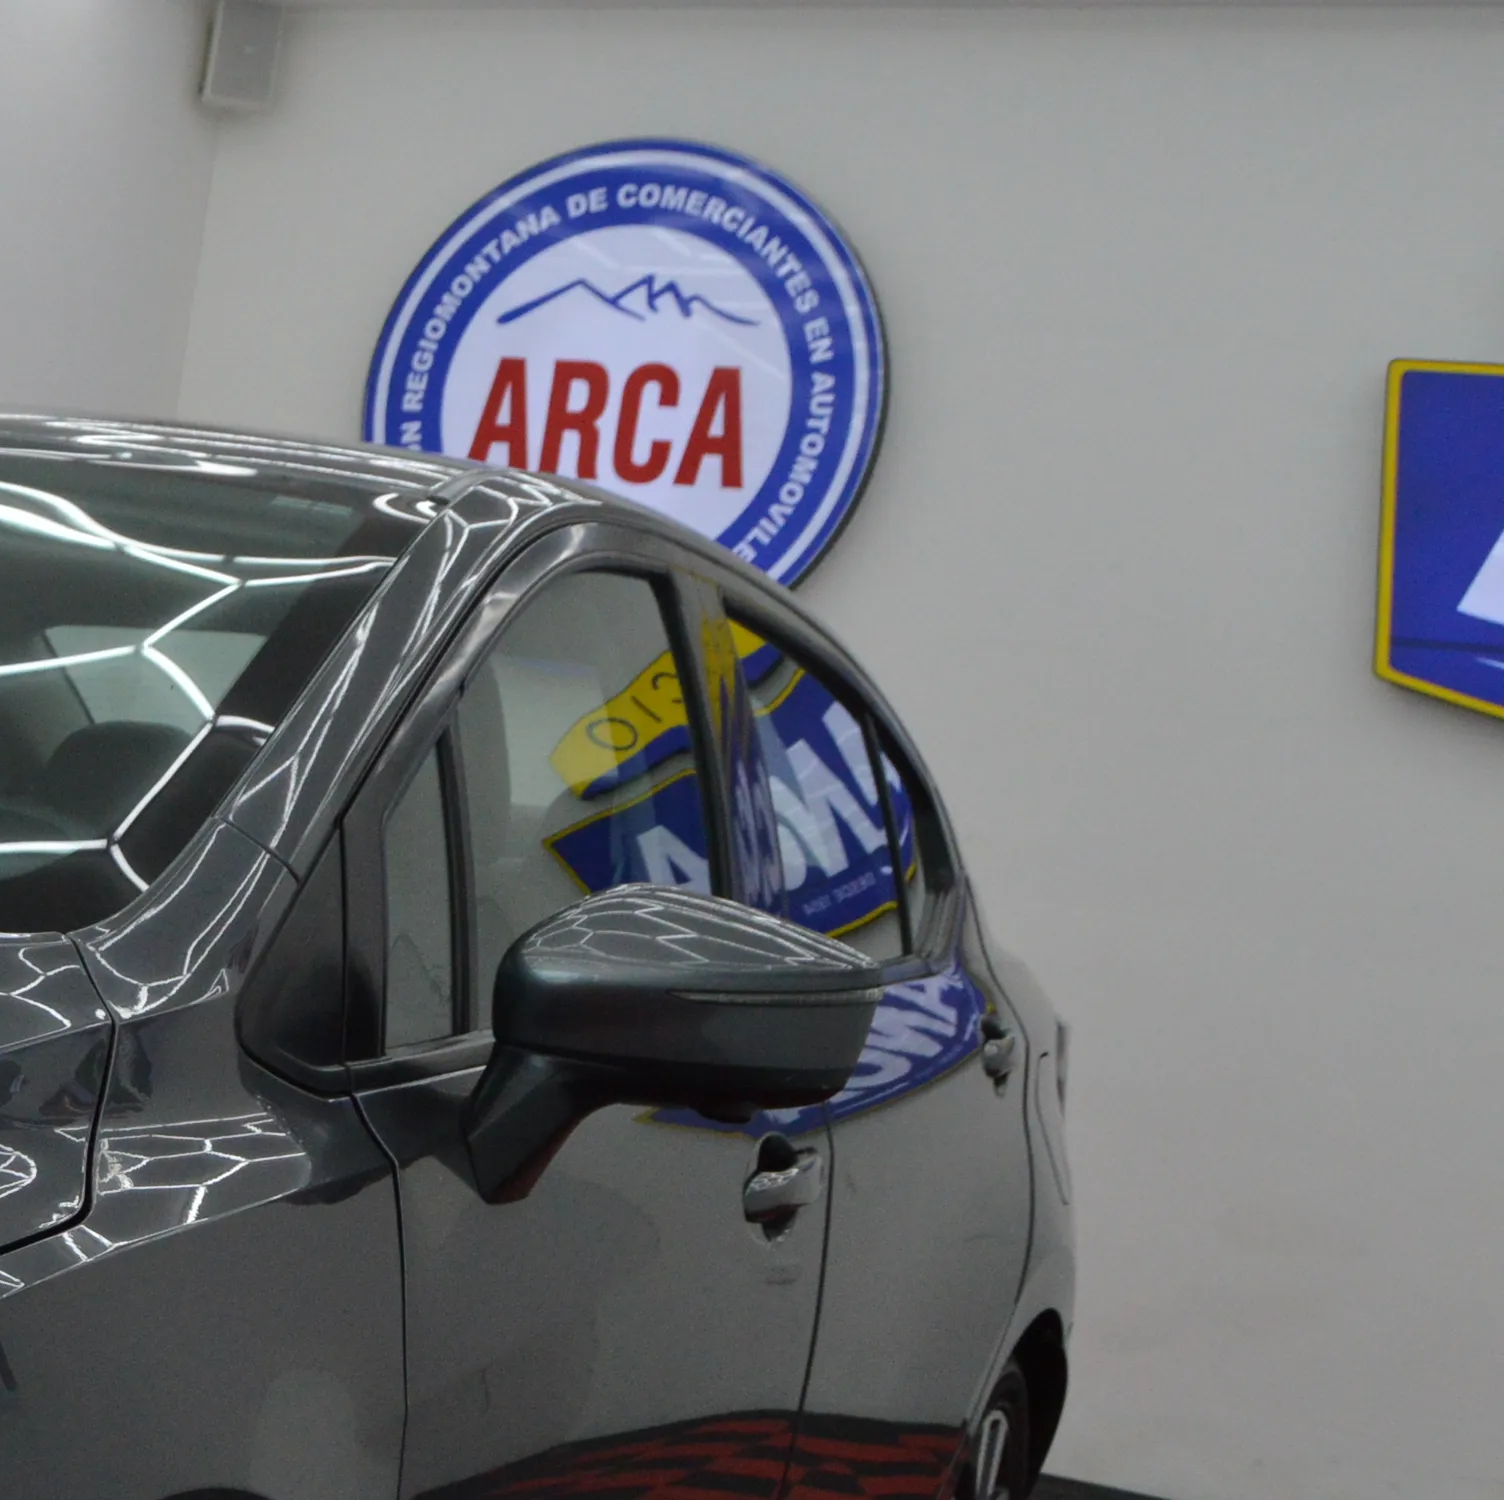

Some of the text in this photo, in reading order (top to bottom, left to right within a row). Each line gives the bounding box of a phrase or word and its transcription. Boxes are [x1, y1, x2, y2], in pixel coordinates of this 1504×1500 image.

[401, 183, 836, 564] REGIOMONTANA DE COMERCIANTES EN AUTOMOVILE
[467, 357, 744, 489] ARCA
